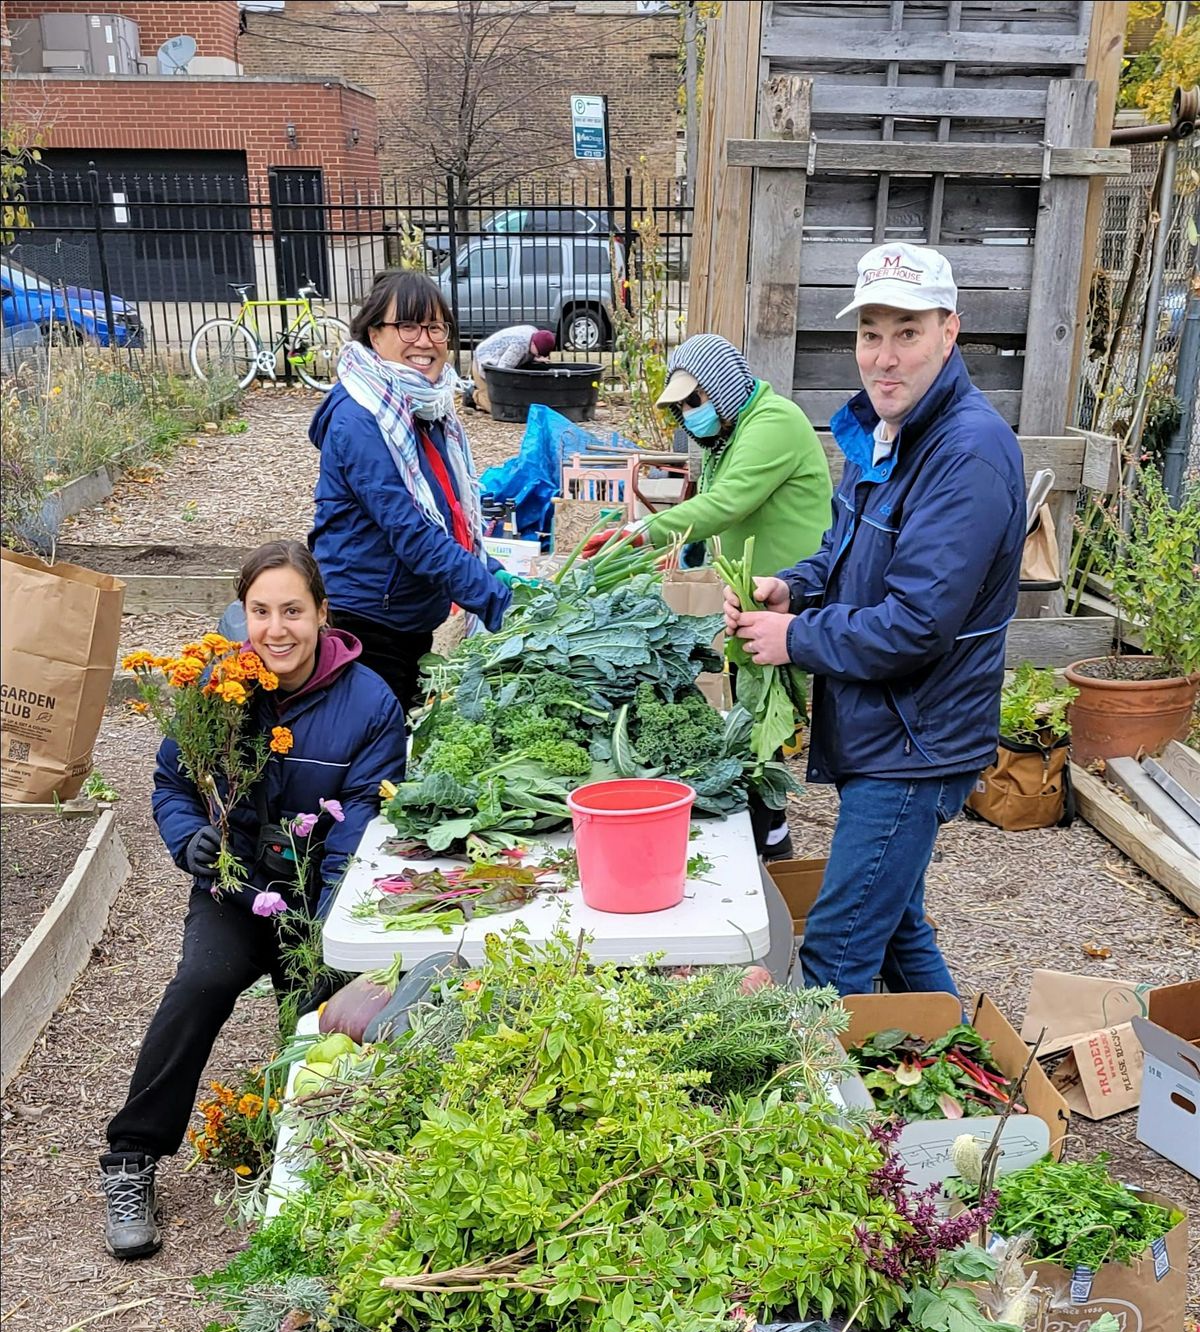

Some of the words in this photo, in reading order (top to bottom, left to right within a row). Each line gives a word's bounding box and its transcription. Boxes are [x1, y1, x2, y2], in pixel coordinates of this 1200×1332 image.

[884, 255, 901, 267] M
[892, 267, 922, 281] HOUSE
[1, 684, 56, 710] GARDEN
[1, 699, 31, 719] LUB
[1088, 1037, 1112, 1096] TRADER
[1118, 1059, 1134, 1092] PLEASE
